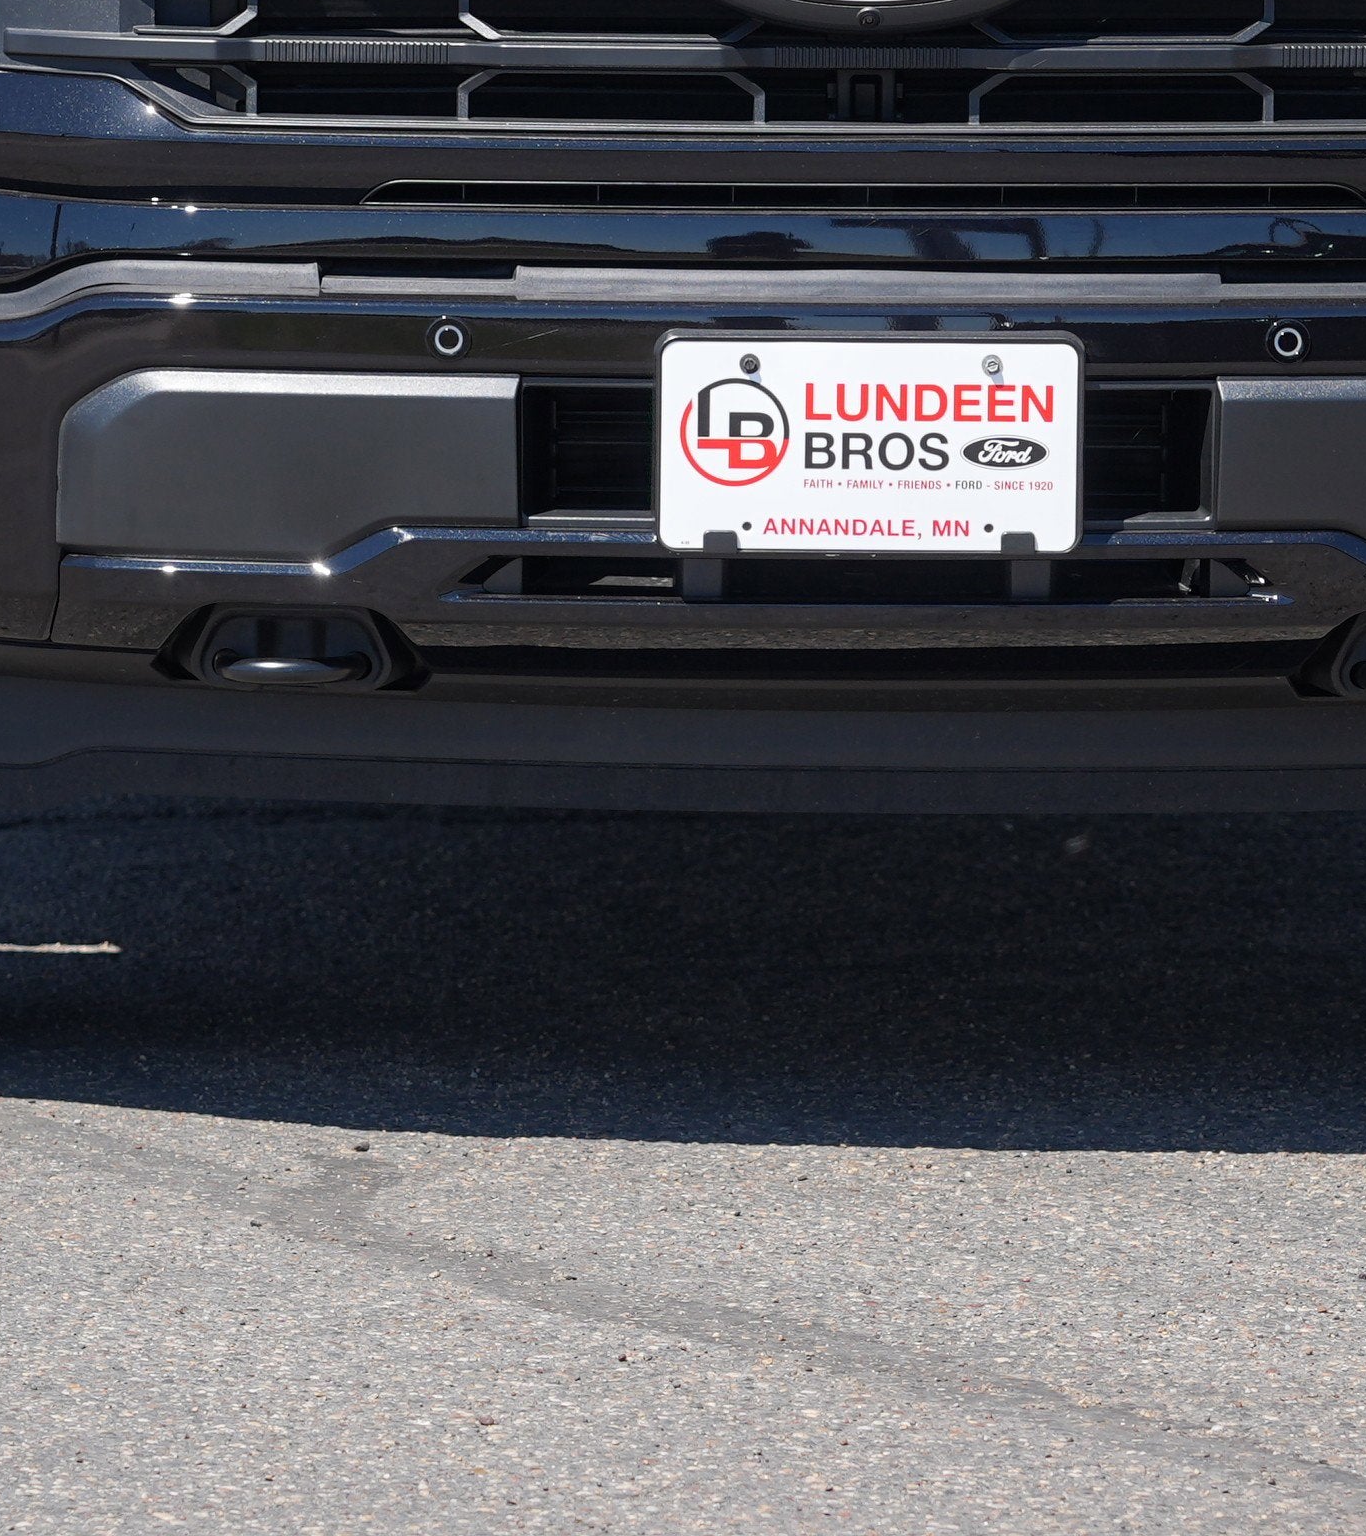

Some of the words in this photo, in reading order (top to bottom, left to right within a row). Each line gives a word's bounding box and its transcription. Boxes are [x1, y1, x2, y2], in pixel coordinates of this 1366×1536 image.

[805, 382, 1054, 423] LUNDEEN
[804, 431, 950, 471] BROS
[977, 439, 1034, 464] Ford
[803, 479, 833, 489] FAITH
[846, 479, 884, 489] FAMILY
[897, 480, 942, 490] FRIENDS
[955, 480, 983, 490] FORD
[994, 481, 1025, 491] SINCE
[1029, 481, 1054, 491] 1920
[763, 517, 922, 540] ANNANDALE,
[932, 519, 970, 537] MN
